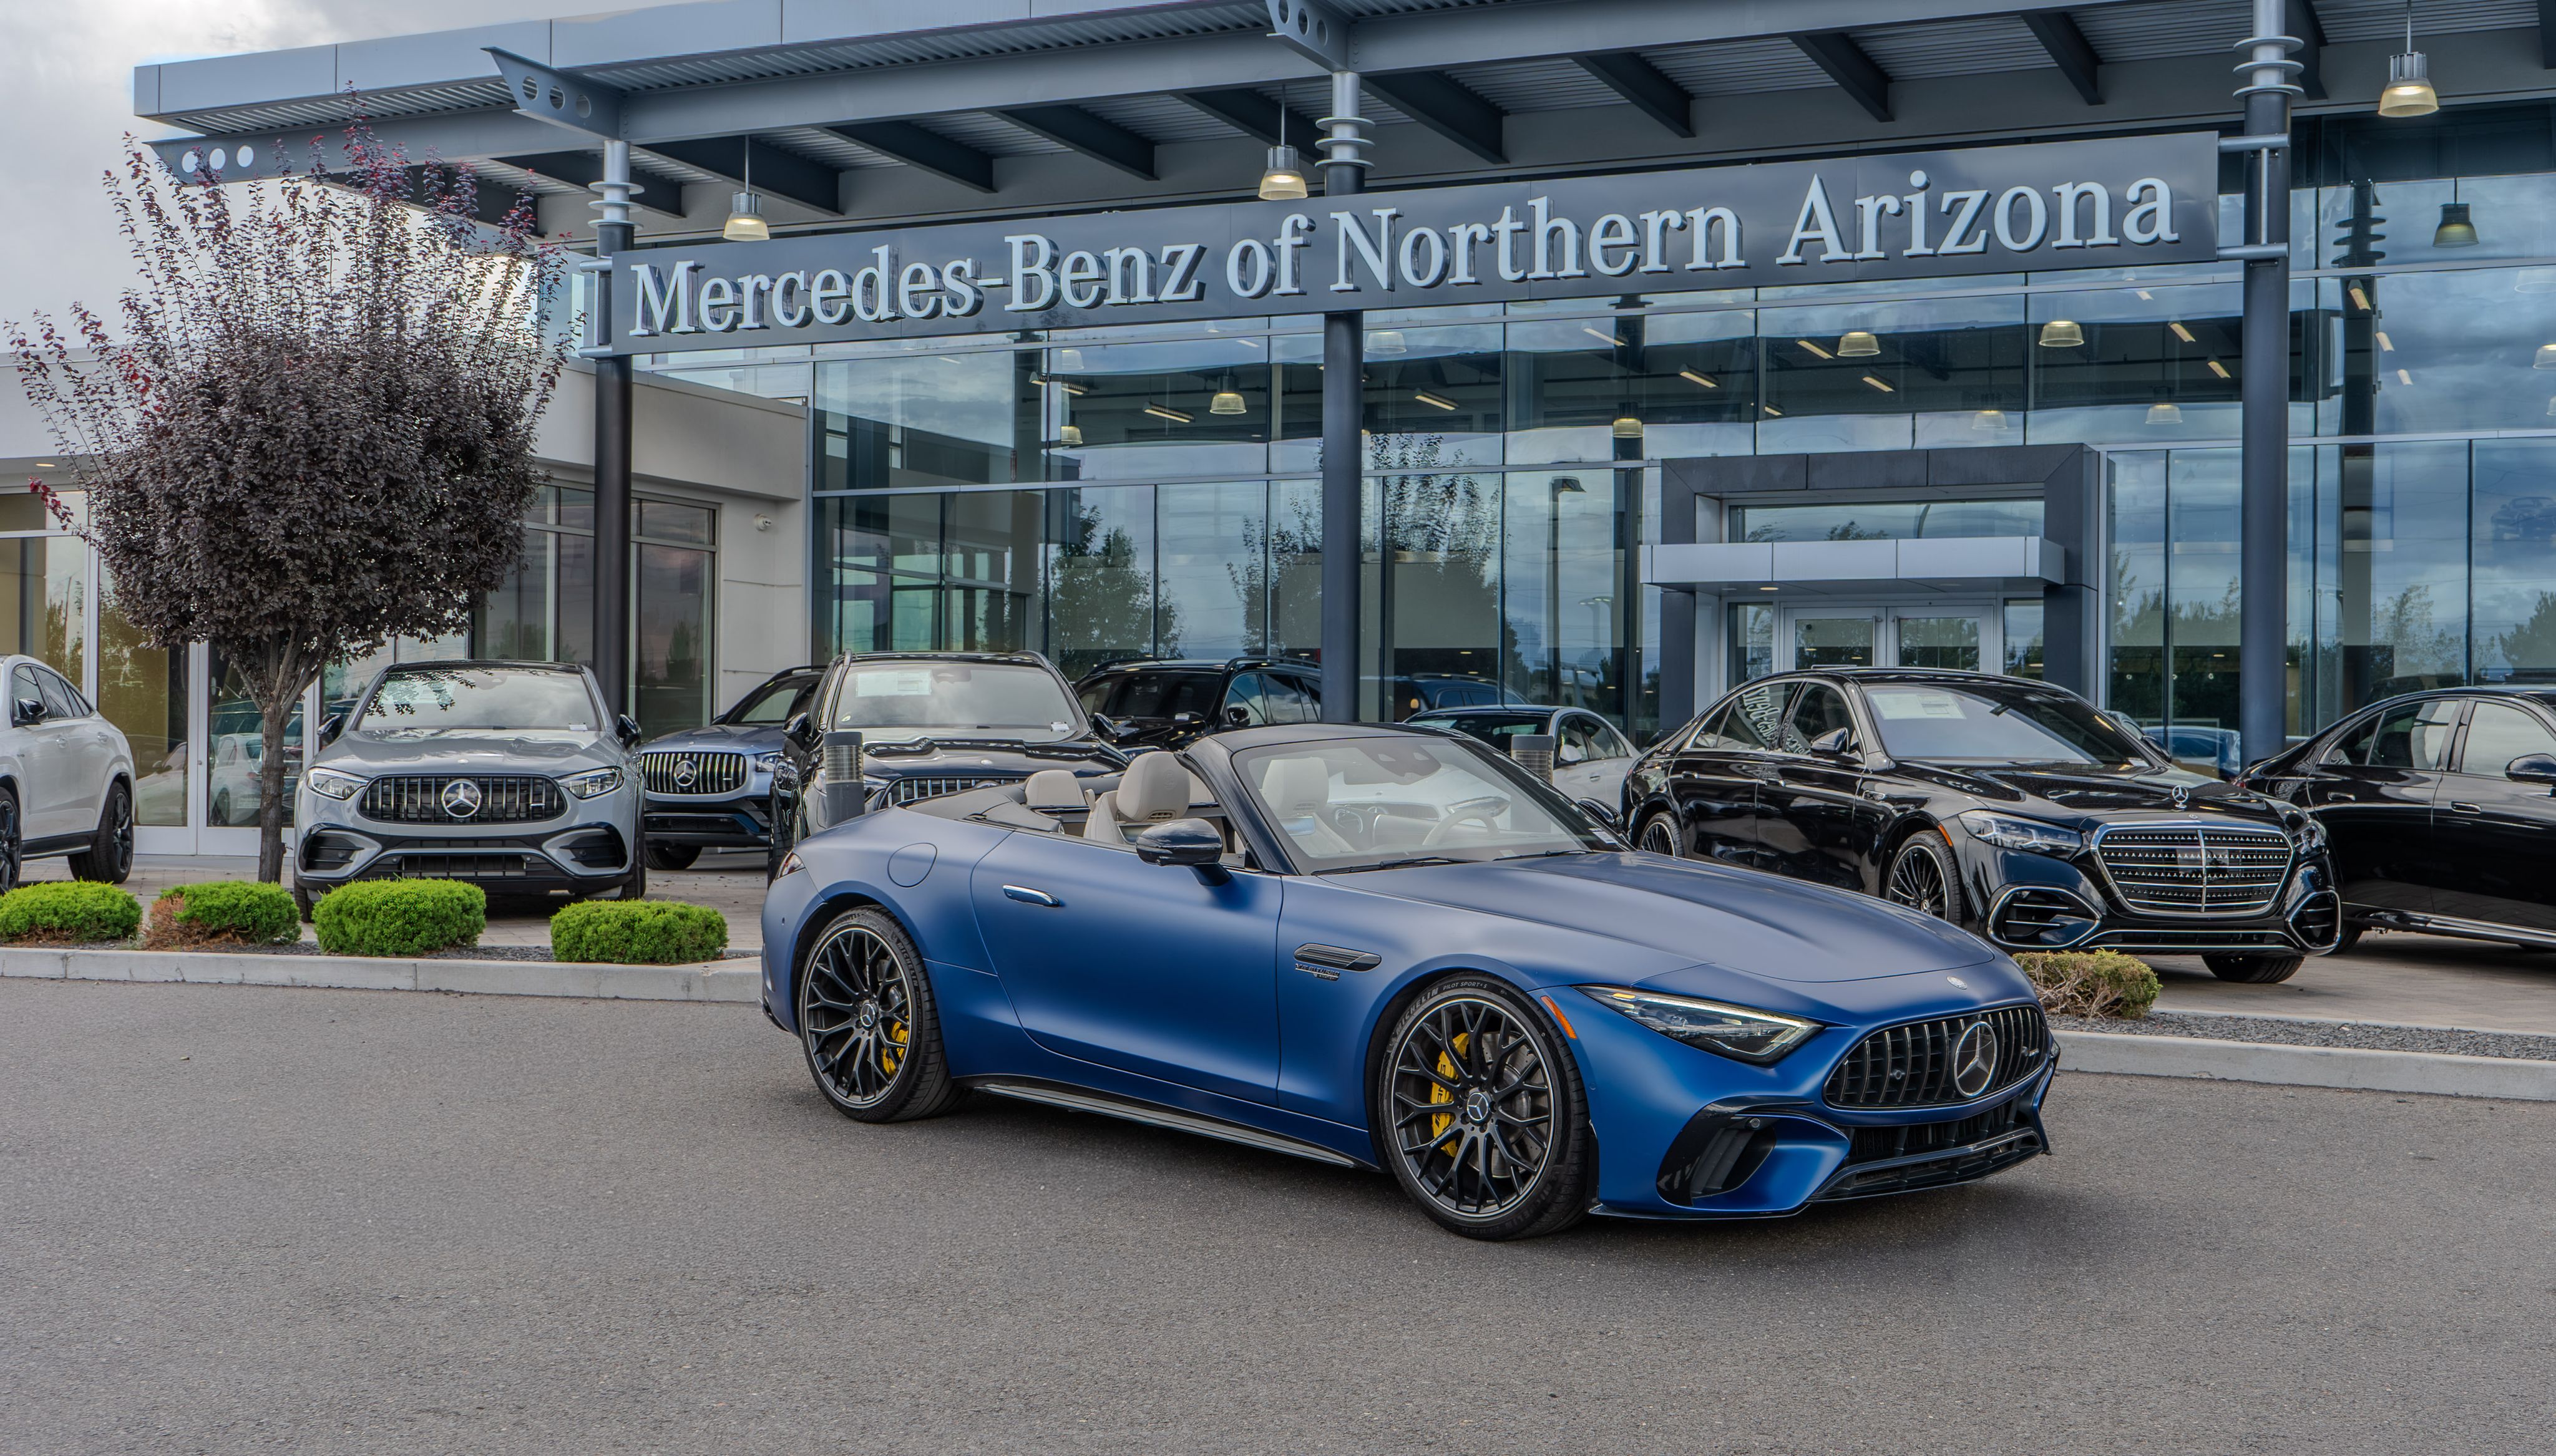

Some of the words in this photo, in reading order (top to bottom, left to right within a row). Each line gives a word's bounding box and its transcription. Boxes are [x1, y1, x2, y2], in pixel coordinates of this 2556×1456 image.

[629, 233, 1208, 337] Mercedes-Benz
[1226, 213, 1316, 300] of
[1330, 196, 1747, 293] Northern
[1775, 170, 2182, 266] Arizona
[897, 941, 919, 987] MICHELIN
[1395, 988, 1439, 1036] MICHELIN
[1443, 982, 1459, 991] PILOT
